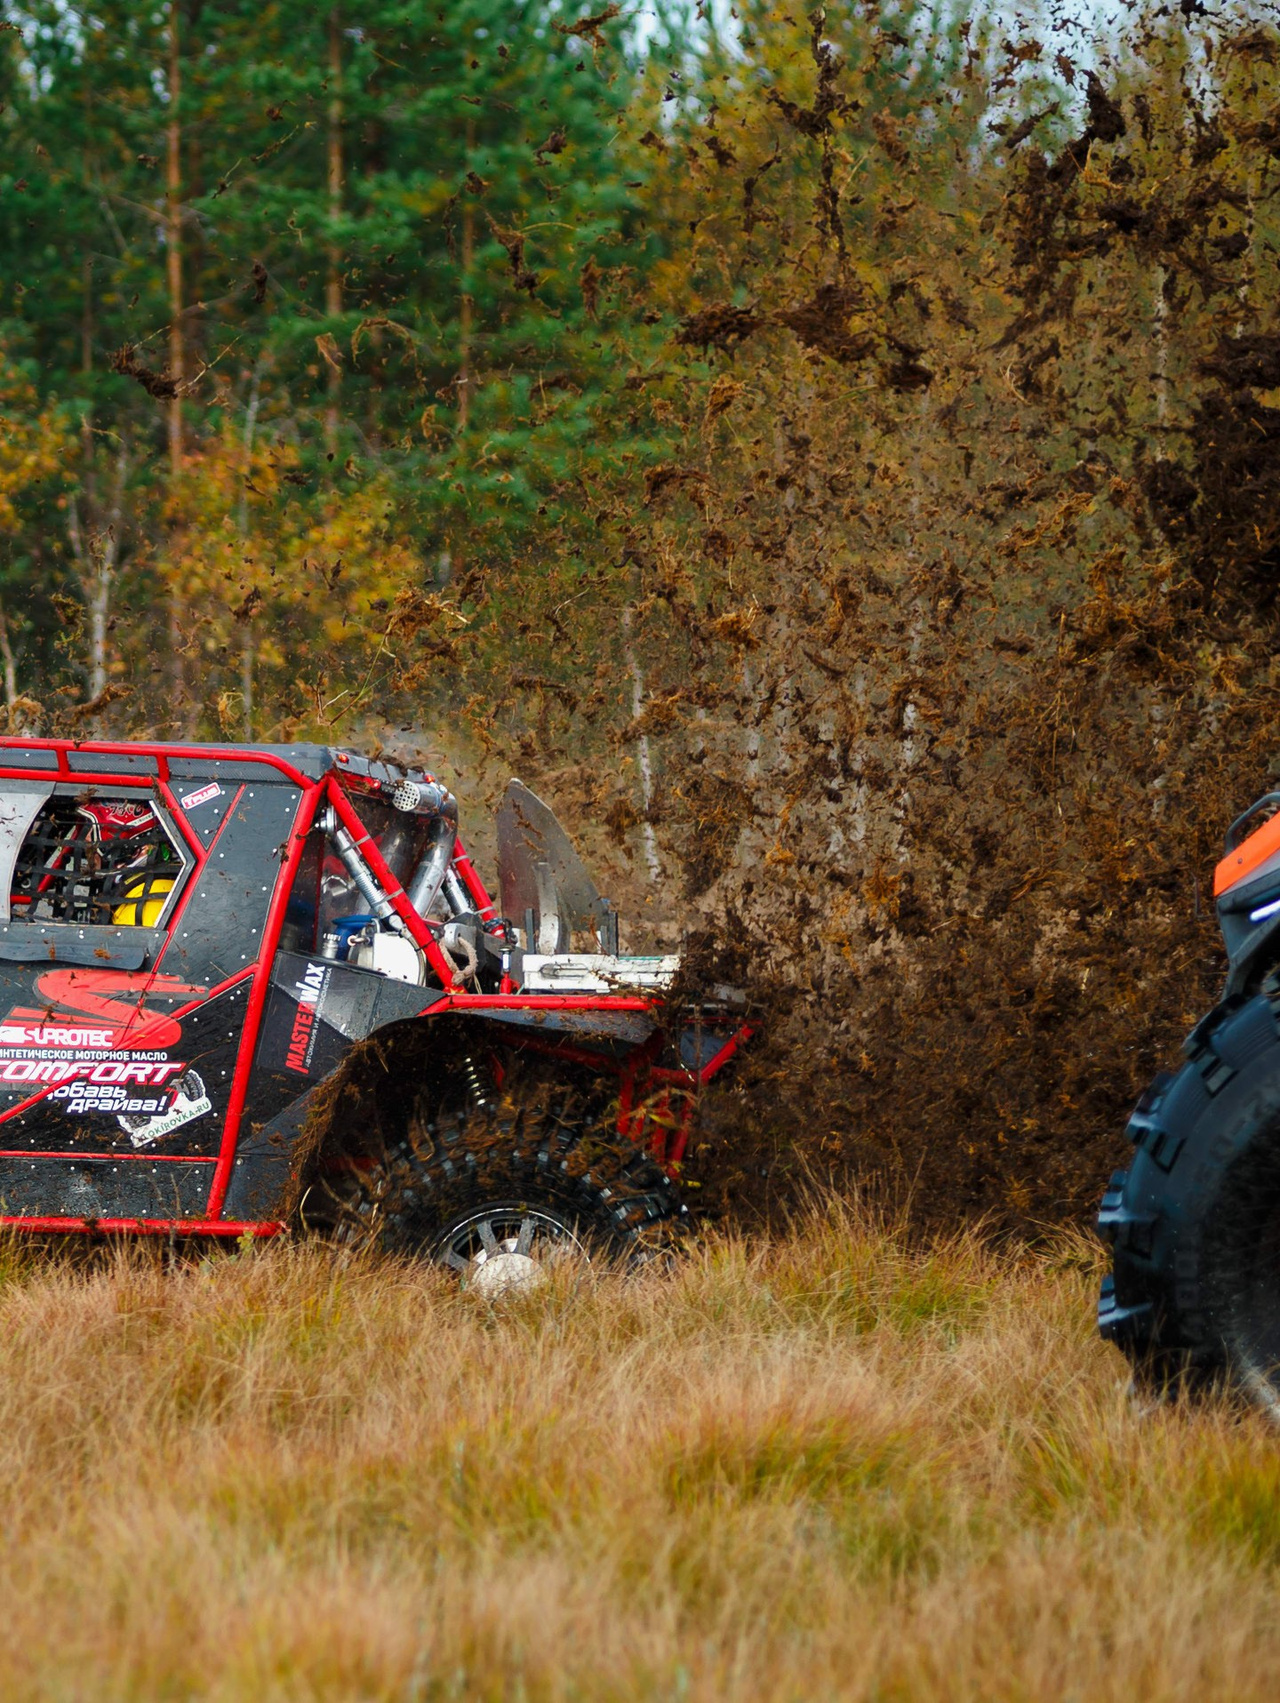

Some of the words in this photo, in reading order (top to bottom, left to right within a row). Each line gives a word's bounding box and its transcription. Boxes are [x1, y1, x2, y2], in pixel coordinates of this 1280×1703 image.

[24, 1027, 113, 1047] SUPROTEC
[75, 1050, 130, 1061] МОТОРНОЕ
[132, 1051, 167, 1061] МАСЛО
[66, 1096, 167, 1113] драйва!
